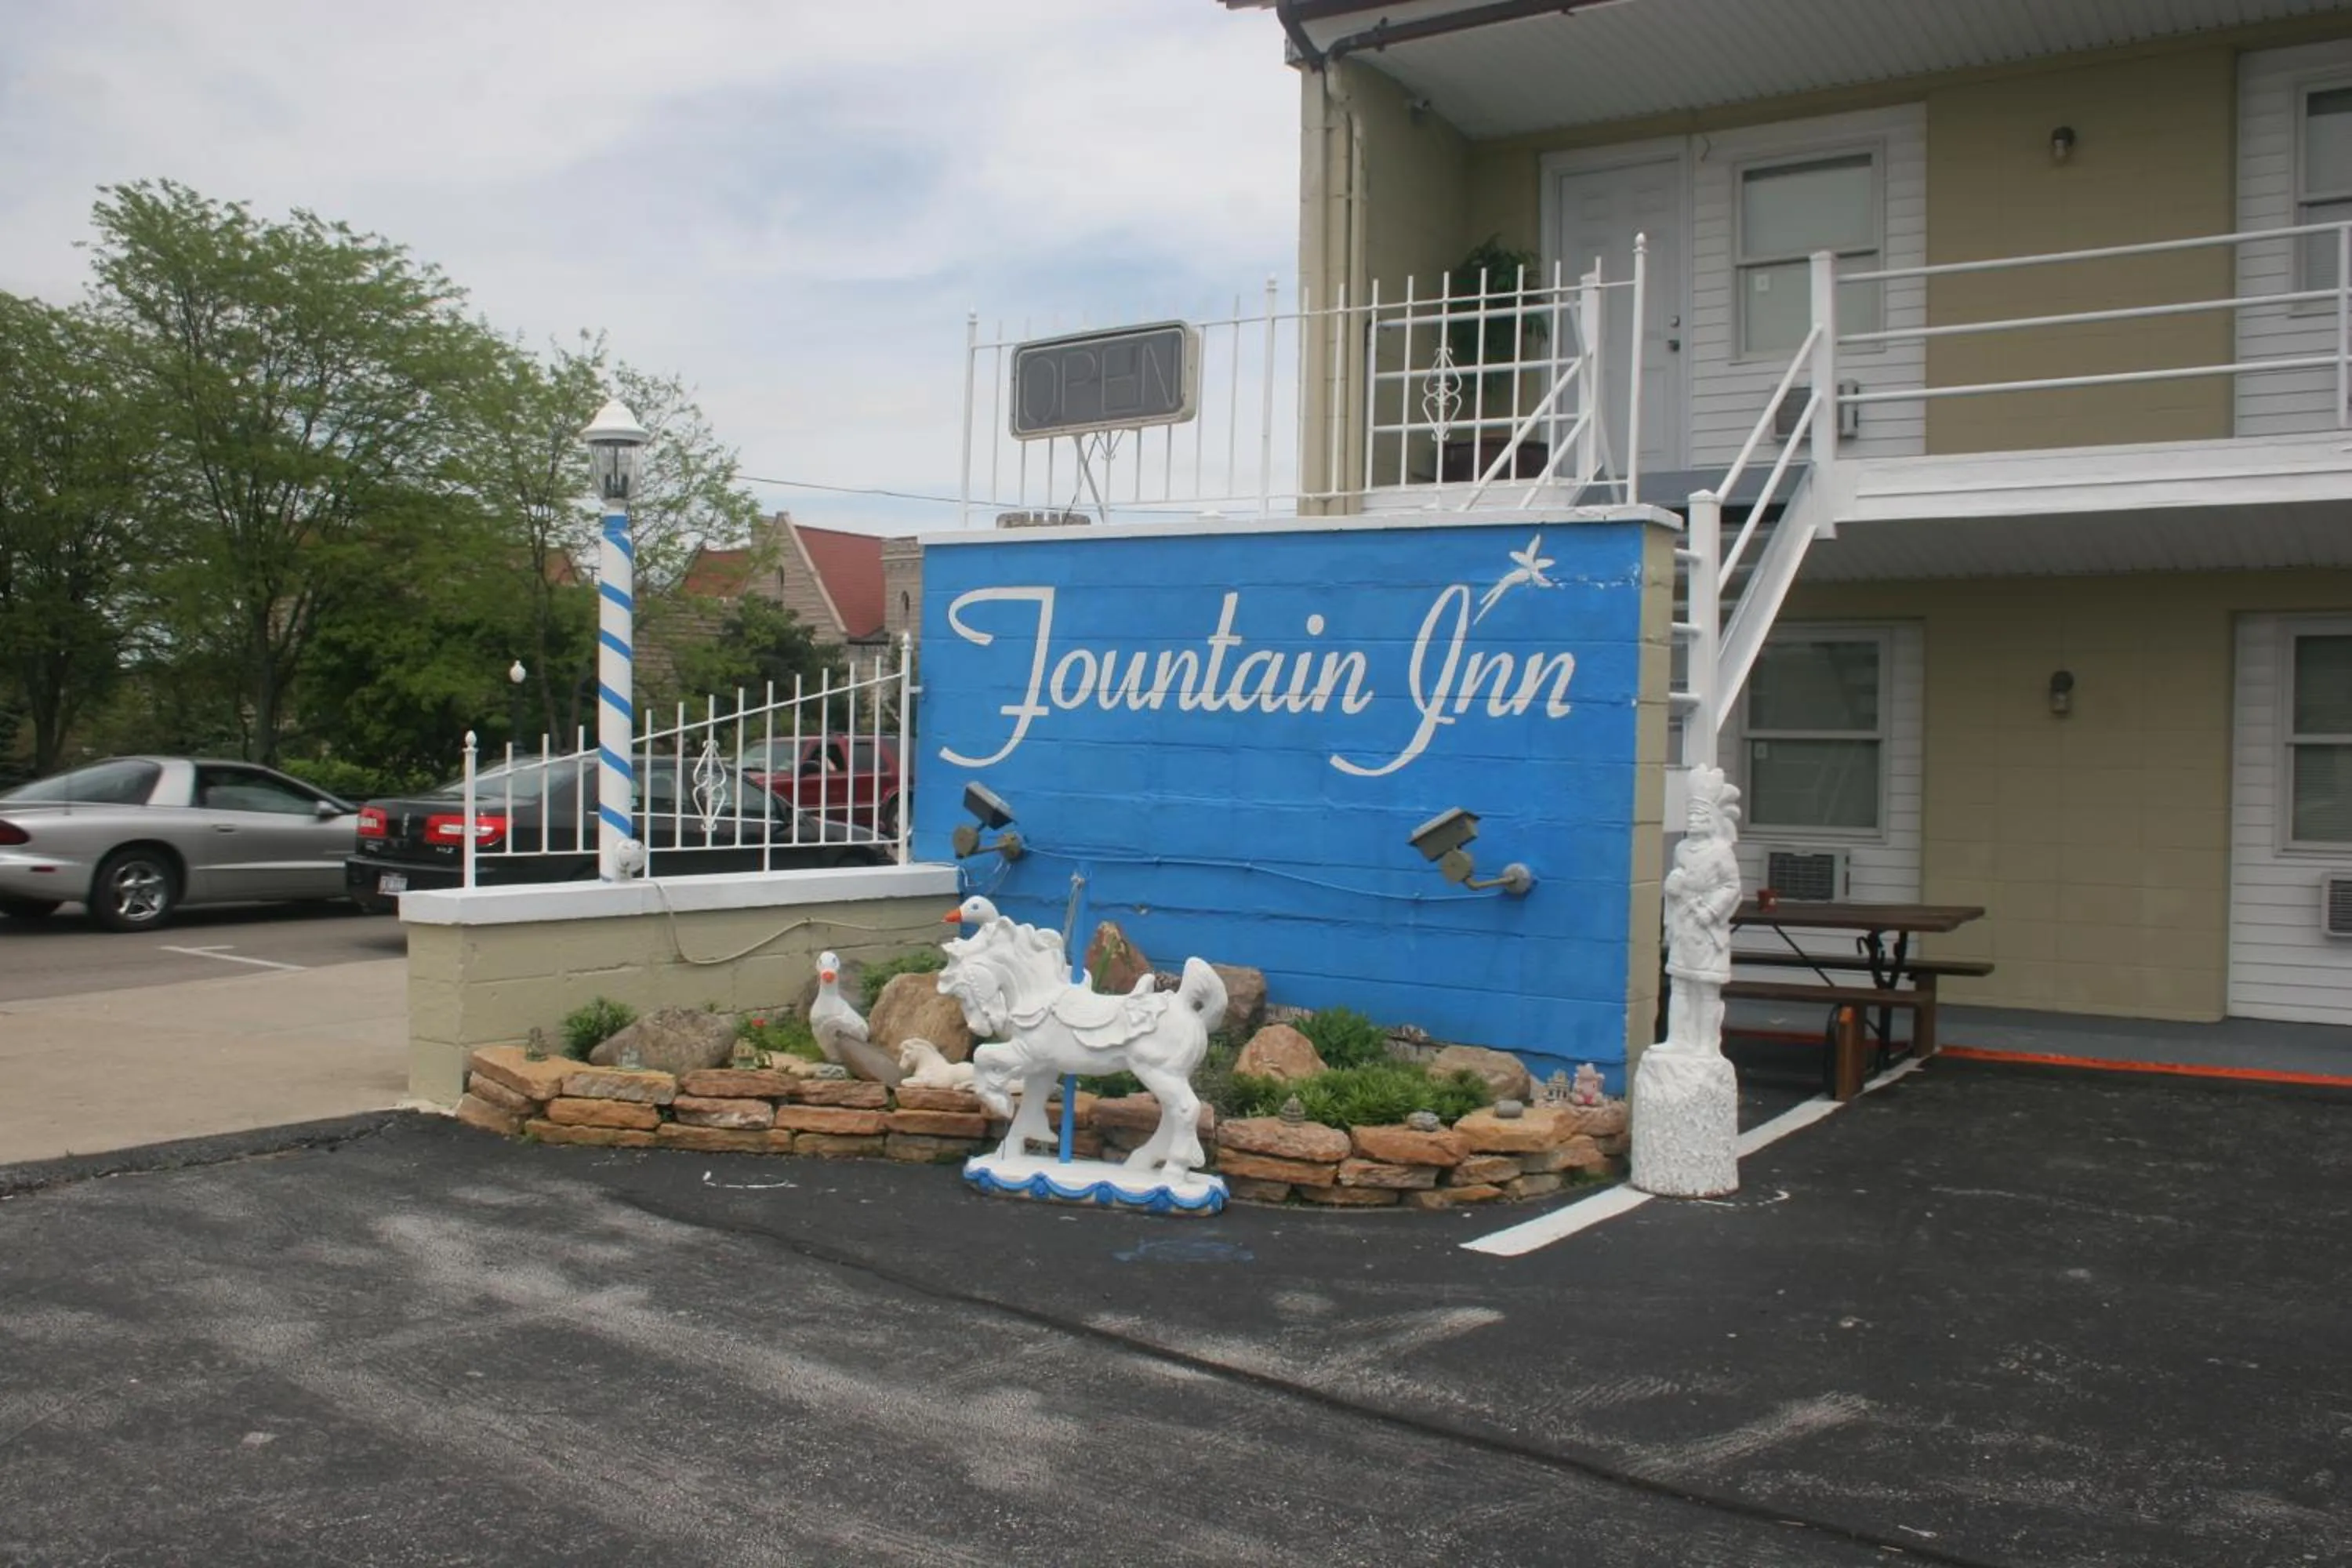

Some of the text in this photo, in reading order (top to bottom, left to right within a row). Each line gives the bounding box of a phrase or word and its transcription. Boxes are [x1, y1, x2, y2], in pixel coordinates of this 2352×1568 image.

[1022, 340, 1178, 423] OPEN
[940, 584, 1575, 776] Fountain Inn
